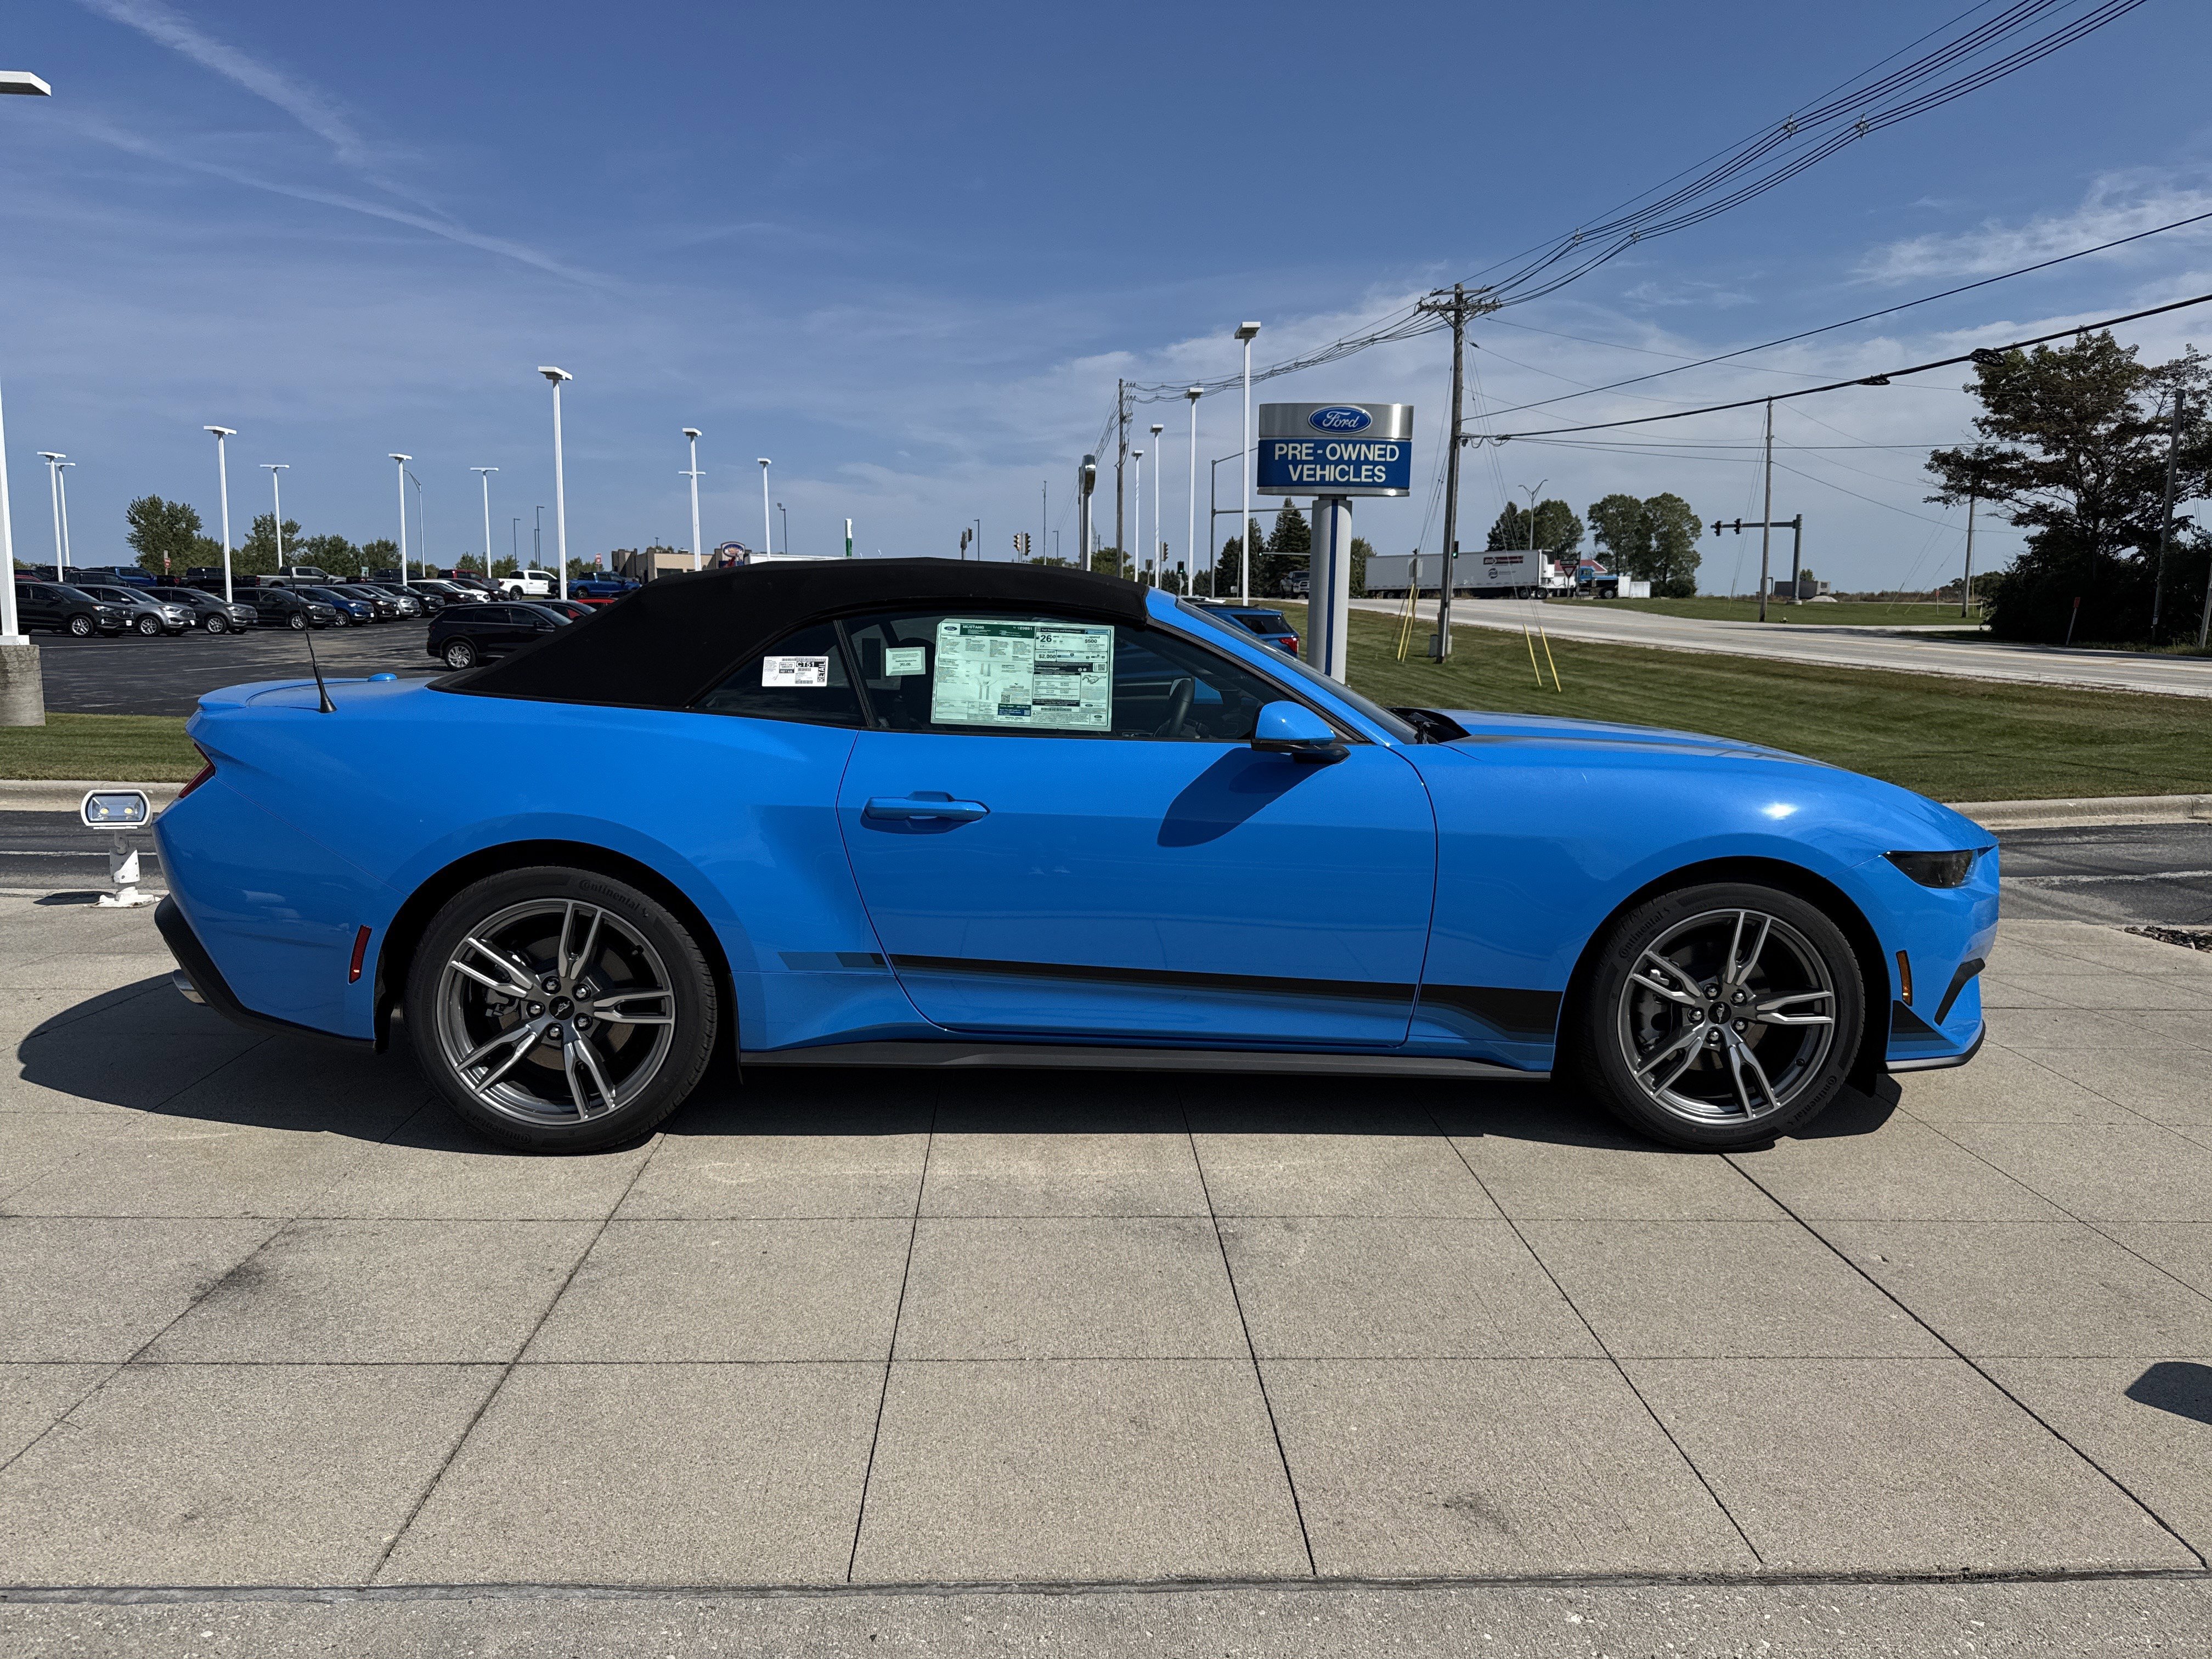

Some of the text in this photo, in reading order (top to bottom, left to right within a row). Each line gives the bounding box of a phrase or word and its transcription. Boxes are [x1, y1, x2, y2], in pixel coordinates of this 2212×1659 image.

[1322, 410, 1360, 428] Ford
[1274, 443, 1400, 462] PRE-OWNED
[1288, 464, 1386, 483] VEHICLES
[579, 879, 640, 910] Continental
[1618, 912, 1665, 959] Continental
[1793, 1075, 1837, 1121] Continental
